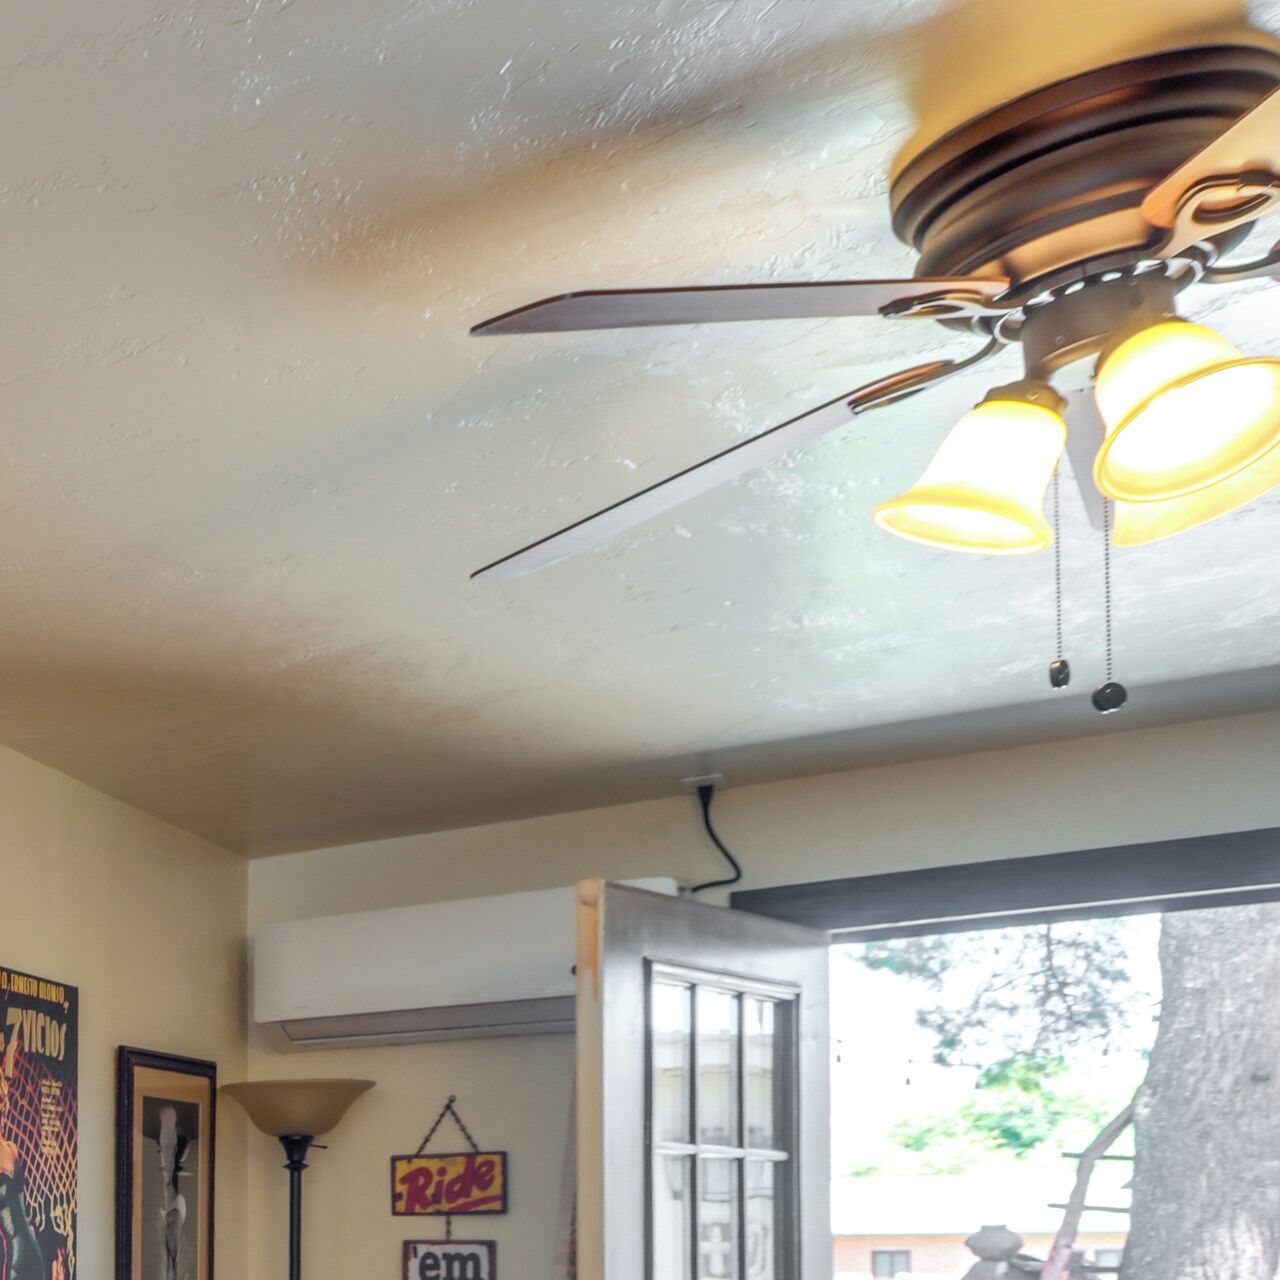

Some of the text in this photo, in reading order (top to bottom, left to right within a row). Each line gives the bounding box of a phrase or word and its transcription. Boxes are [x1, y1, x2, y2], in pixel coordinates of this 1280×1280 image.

[5, 1007, 23, 1078] 7
[23, 1009, 67, 1061] VICIOS
[399, 1156, 496, 1213] Ride
